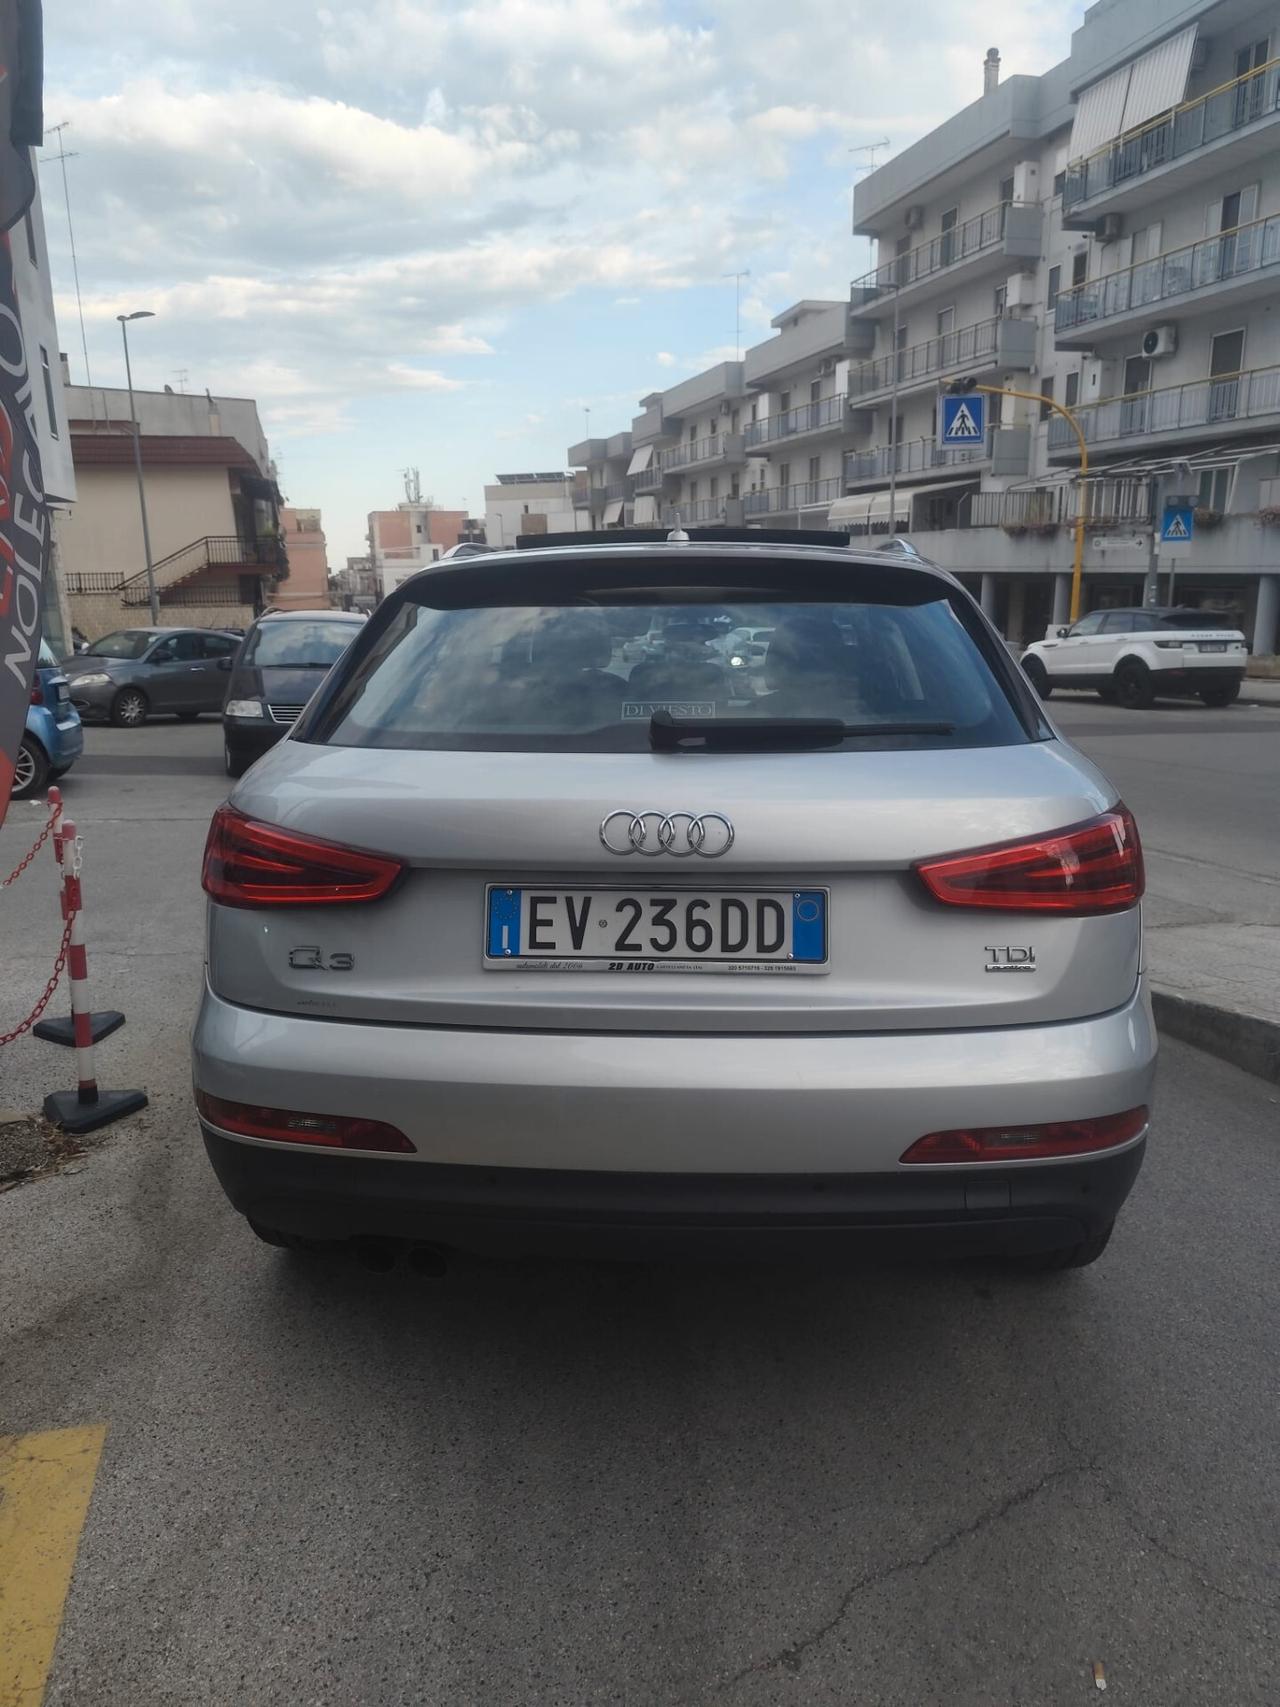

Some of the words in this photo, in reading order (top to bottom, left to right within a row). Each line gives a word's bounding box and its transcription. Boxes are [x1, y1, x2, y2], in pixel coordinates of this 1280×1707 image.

[626, 704, 644, 716] DI
[529, 896, 593, 951] EV
[614, 897, 785, 953] 236DD
[289, 945, 355, 972] Q3
[984, 945, 1036, 963] TDI
[608, 962, 624, 971] 2D
[626, 962, 655, 971] AUTO
